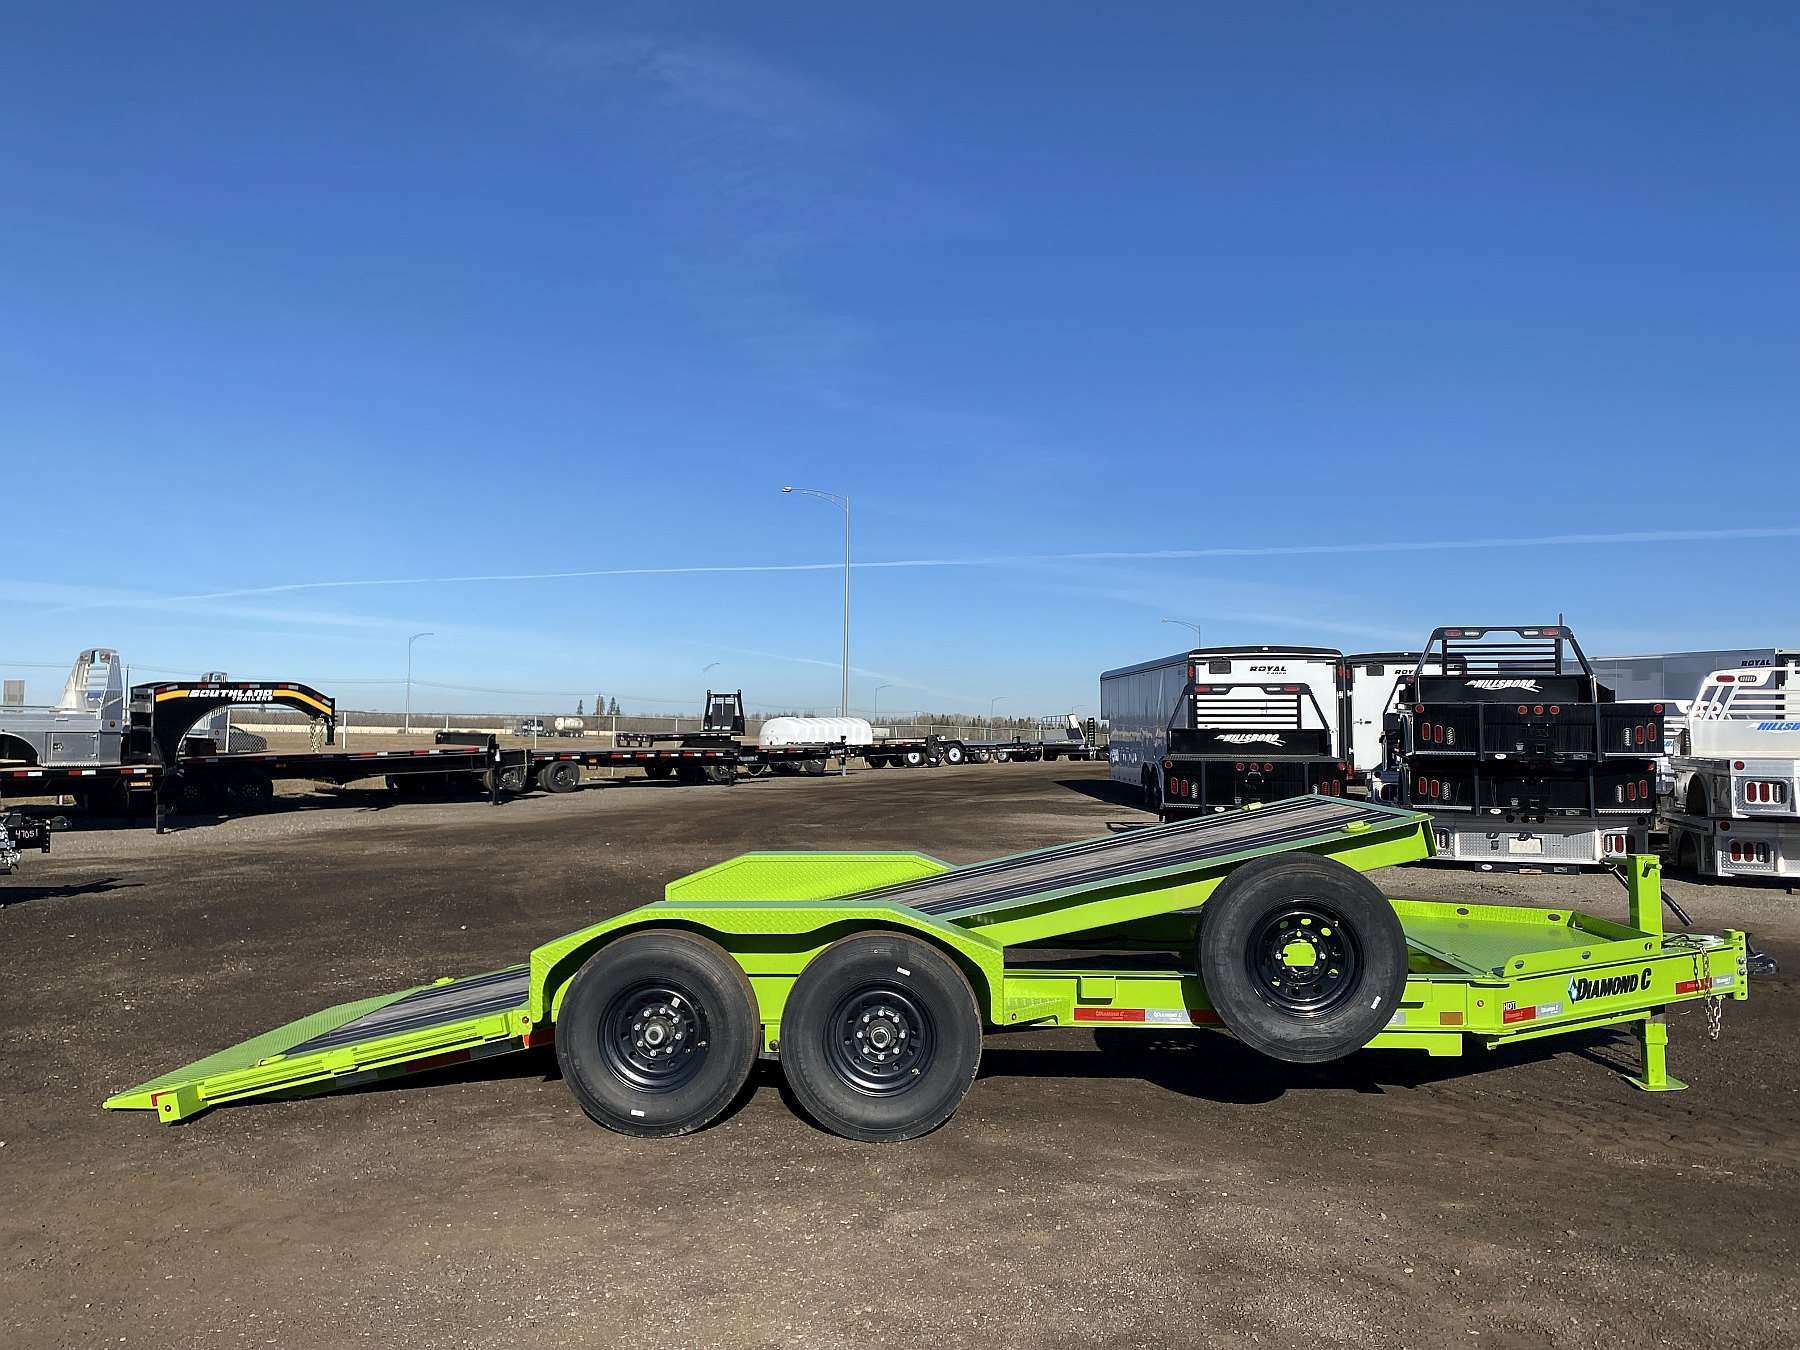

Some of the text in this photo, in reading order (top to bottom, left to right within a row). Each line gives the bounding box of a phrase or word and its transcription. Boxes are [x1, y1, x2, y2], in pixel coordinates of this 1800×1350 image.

[1741, 659, 1771, 667] ROYAL
[1470, 679, 1538, 689] HILLSBORO
[189, 689, 273, 698] SOUTHLAND
[1220, 733, 1281, 743] HILLSBORO
[1576, 967, 1652, 1002] DIAMOND C
[1503, 1001, 1516, 1012] HDT
